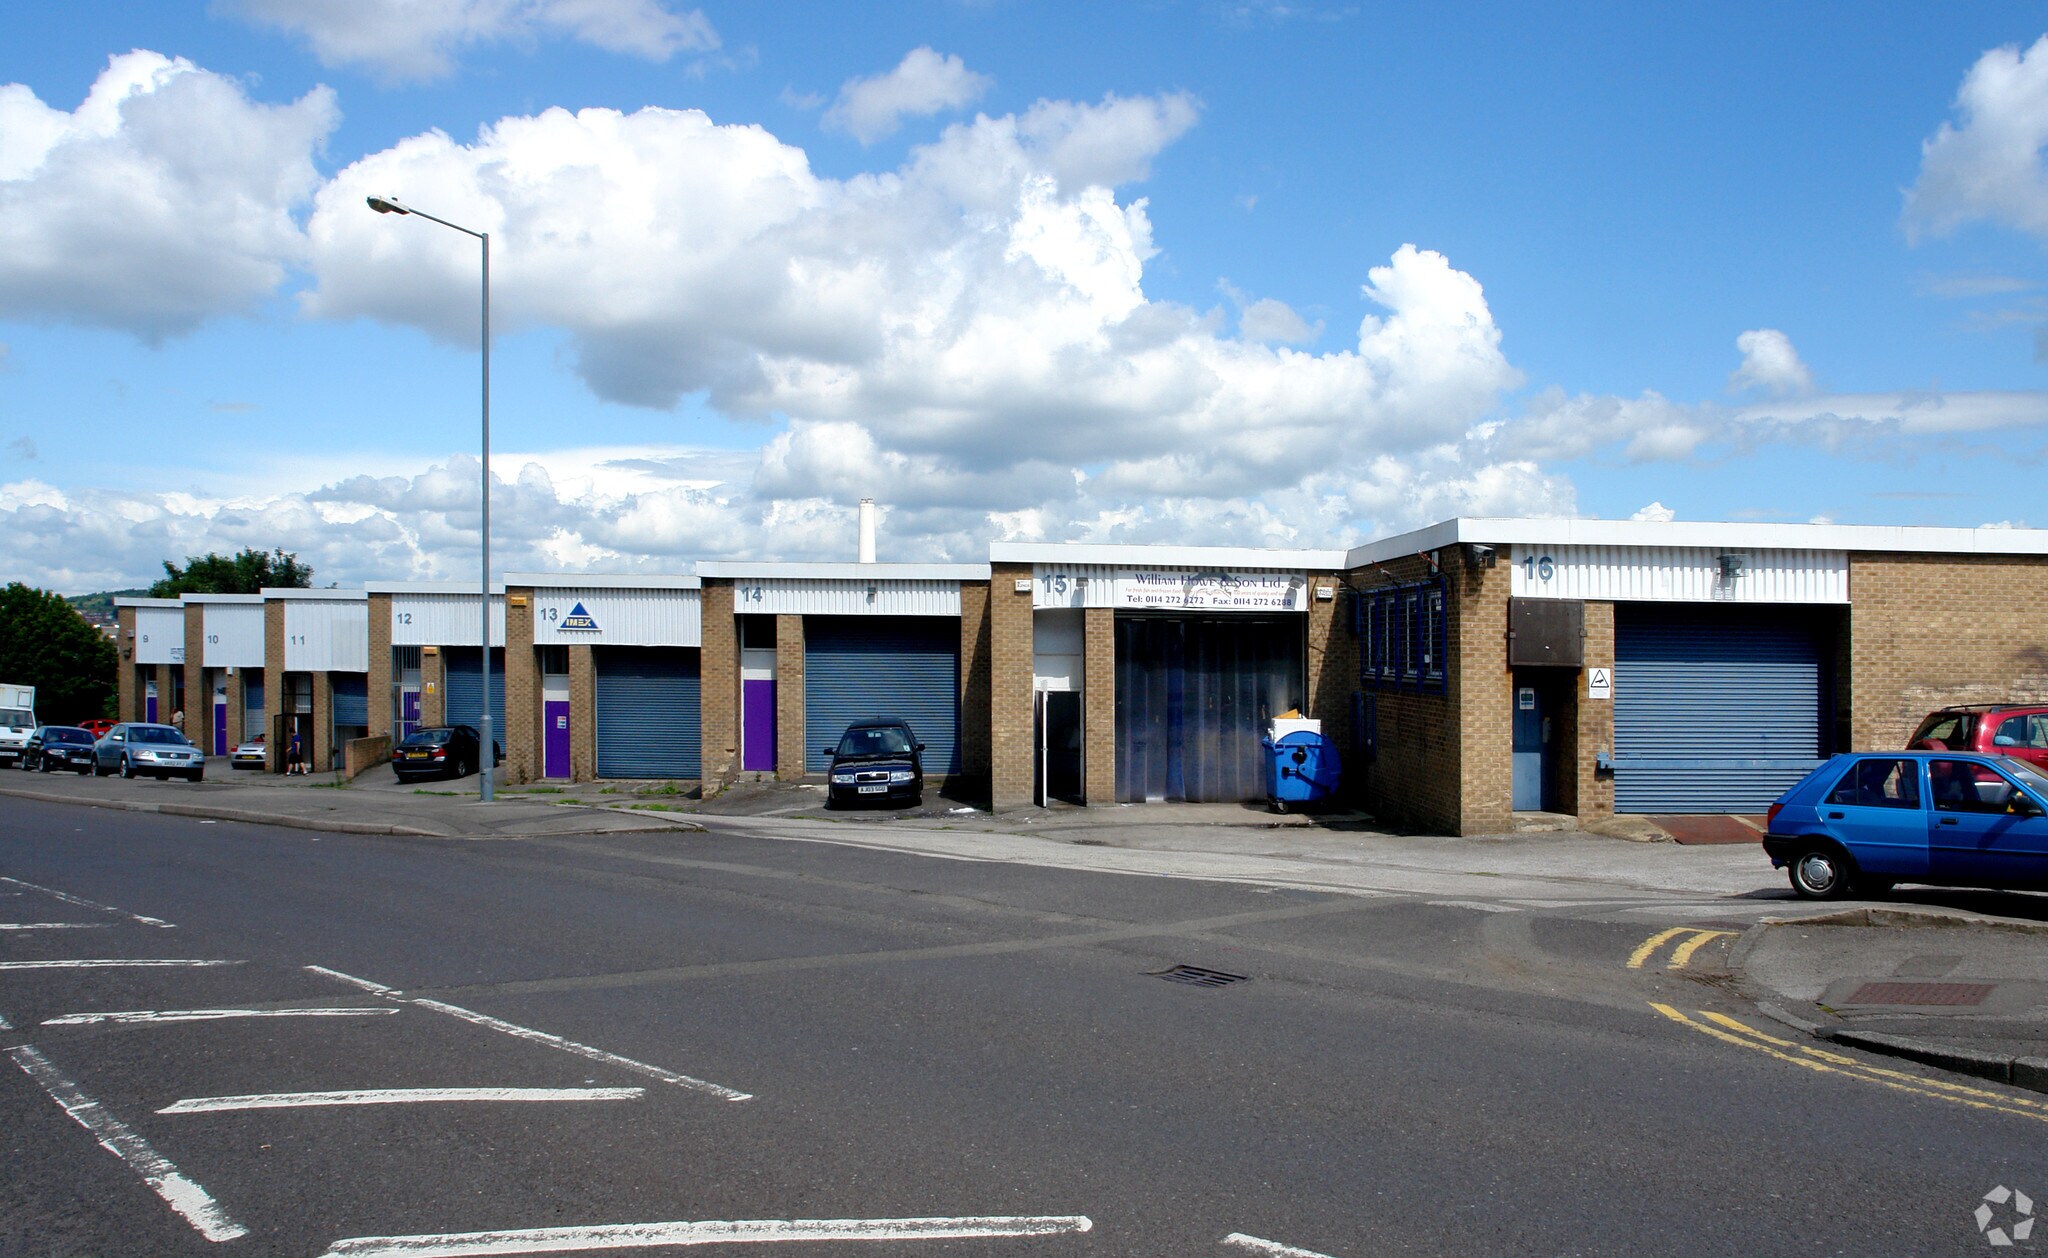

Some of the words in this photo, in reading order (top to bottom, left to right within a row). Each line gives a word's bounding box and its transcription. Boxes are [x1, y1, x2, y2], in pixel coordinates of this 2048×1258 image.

[1523, 556, 1554, 582] 16
[1044, 574, 1067, 594] 15
[1135, 573, 1176, 586] William
[1220, 575, 1231, 587] &
[1234, 576, 1257, 588] Son
[1262, 576, 1285, 589] Ltd.
[740, 587, 763, 602] 14
[1126, 595, 1143, 603] Tel:
[1145, 595, 1163, 603] 0114
[1165, 596, 1181, 604] 272
[1213, 597, 1231, 605] Fax:
[1233, 597, 1251, 605] 0114
[1253, 598, 1269, 606] 272
[1271, 598, 1292, 606] 6288
[397, 613, 413, 625] 12
[540, 607, 558, 621] 13
[566, 618, 592, 627] IMEX
[142, 634, 149, 643] 9
[207, 634, 219, 644] 10
[291, 635, 305, 645] 11
